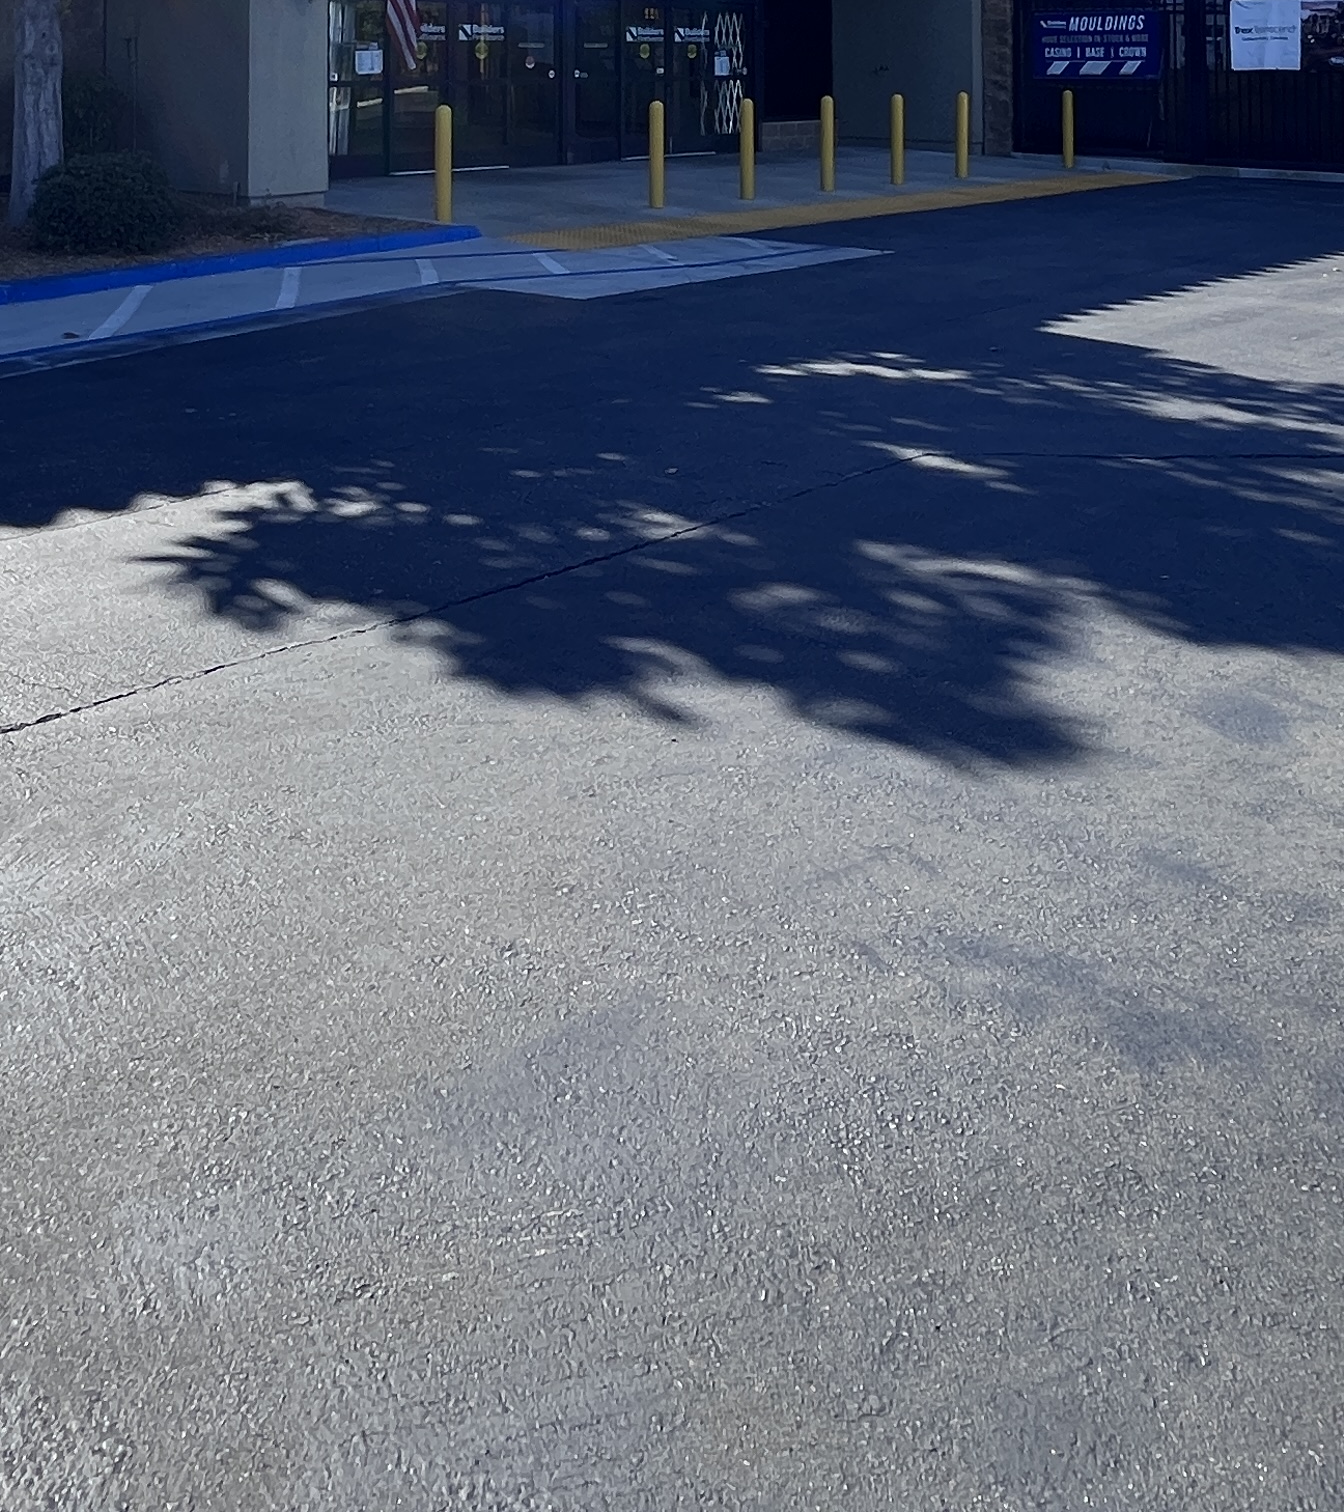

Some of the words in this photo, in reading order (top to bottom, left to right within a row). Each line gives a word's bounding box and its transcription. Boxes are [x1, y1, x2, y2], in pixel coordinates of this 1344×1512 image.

[1068, 15, 1145, 31] MOULDINGS
[1044, 47, 1072, 58] CASING
[1085, 47, 1105, 58] BASE
[1119, 46, 1147, 58] CROWN
